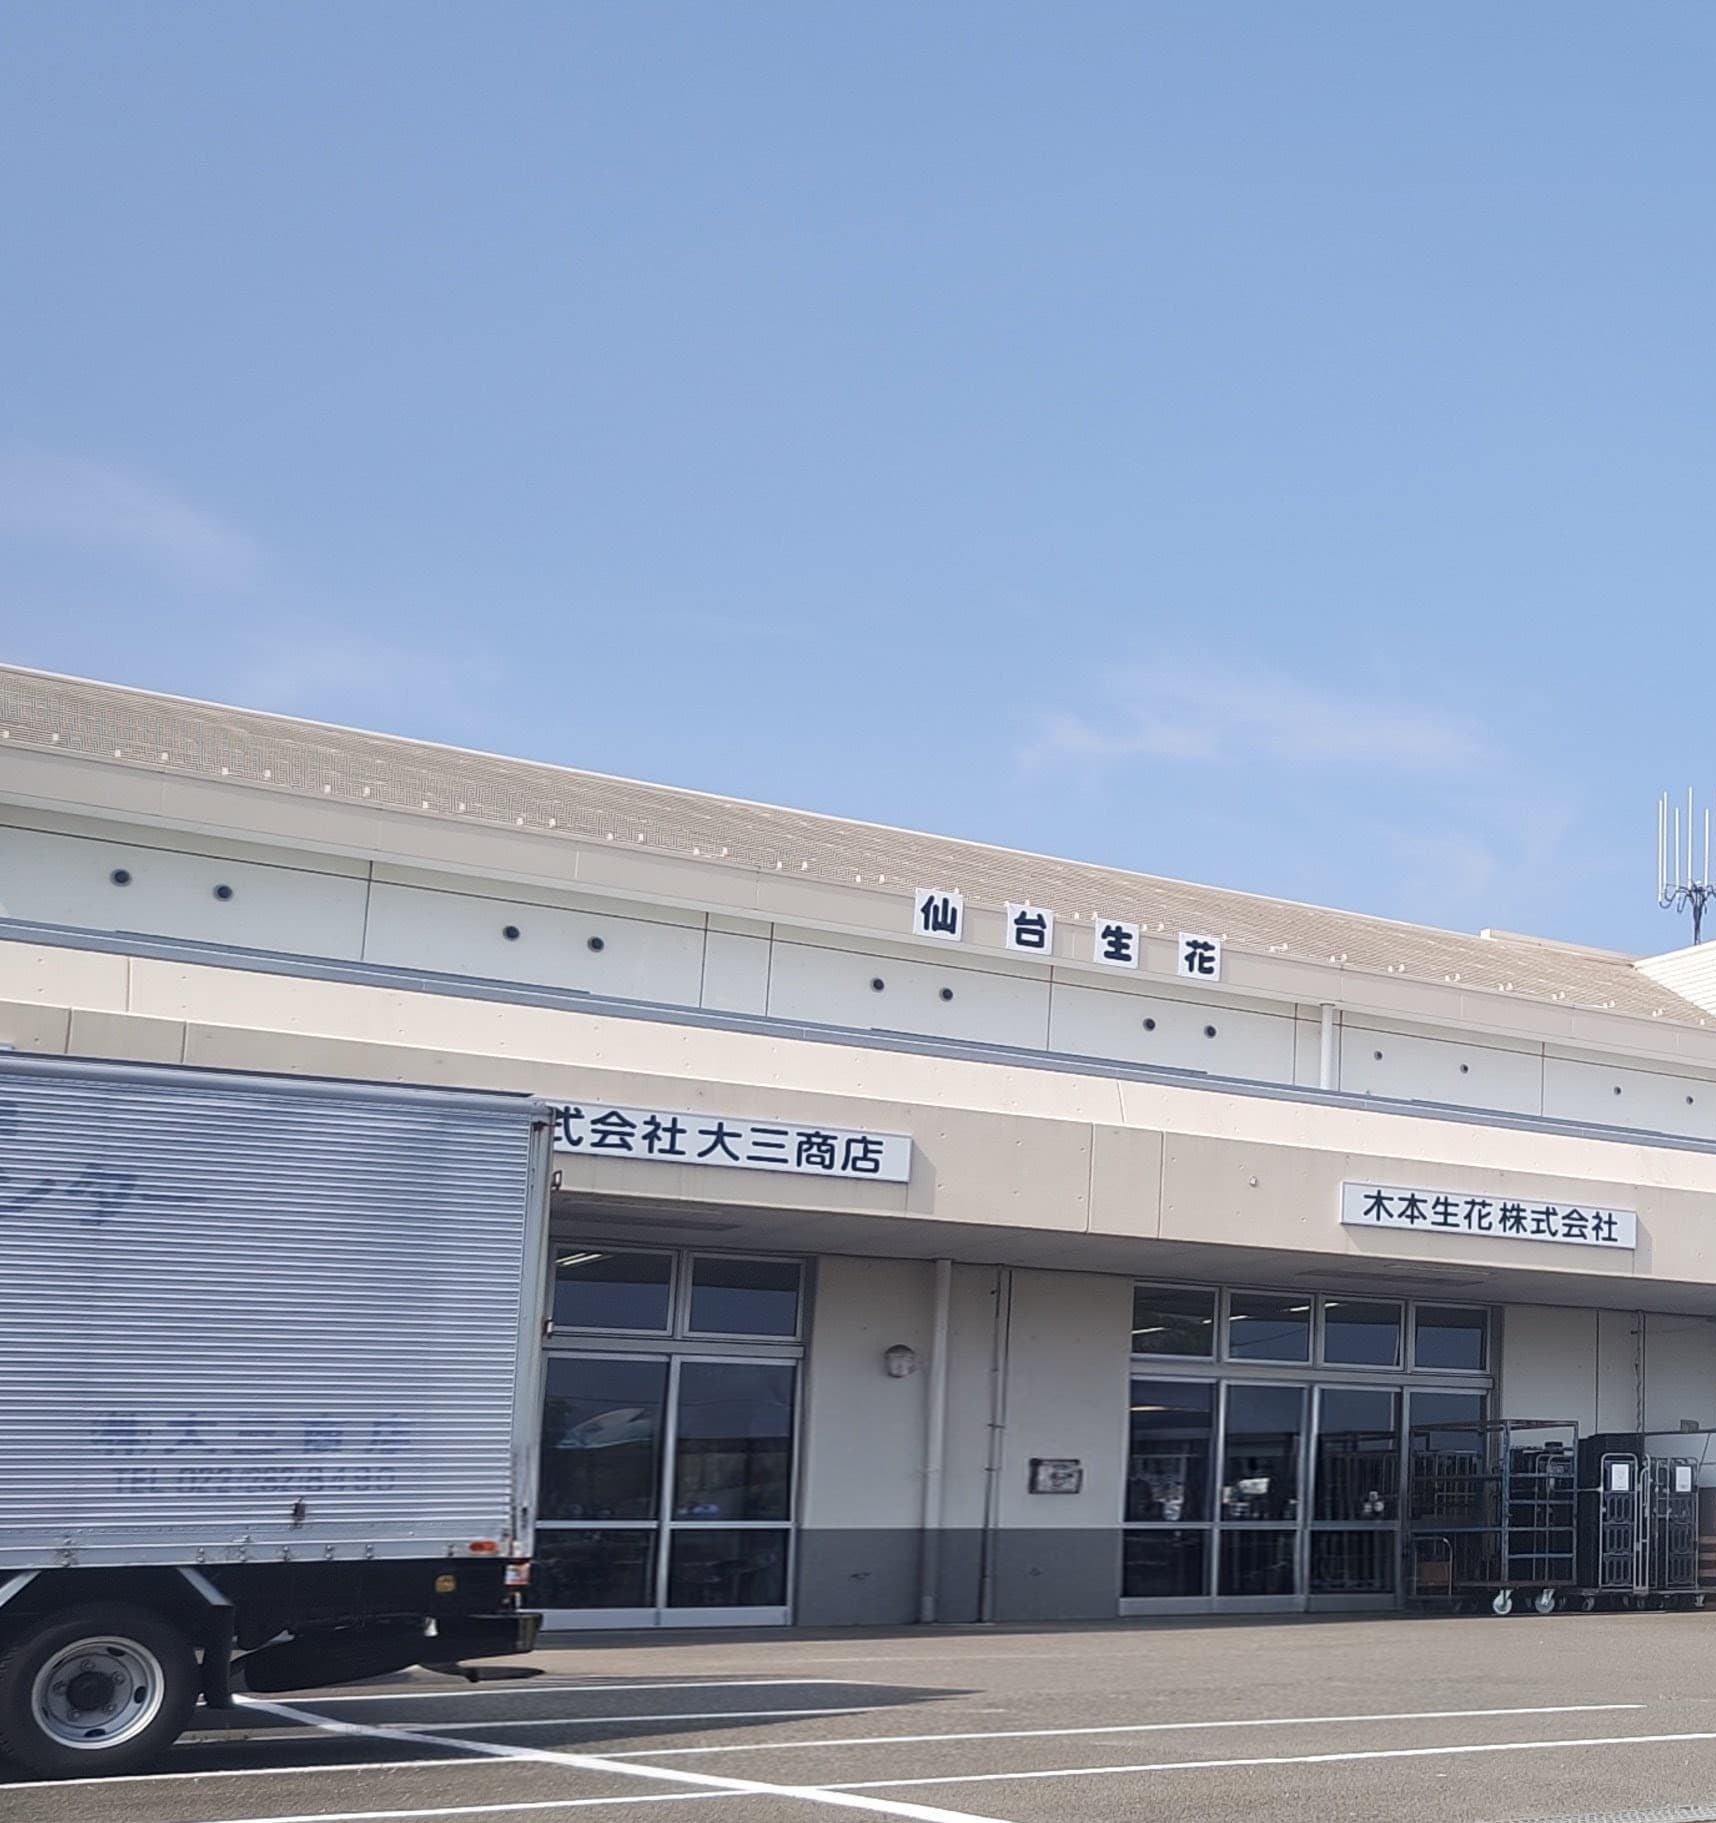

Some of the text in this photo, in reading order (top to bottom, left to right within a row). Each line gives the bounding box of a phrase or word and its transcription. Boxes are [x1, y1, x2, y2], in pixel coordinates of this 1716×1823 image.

[920, 895, 1216, 974] 仙台生花
[1363, 1189, 1619, 1243] 木本生花株式会社
[112, 1466, 162, 1493] TEL
